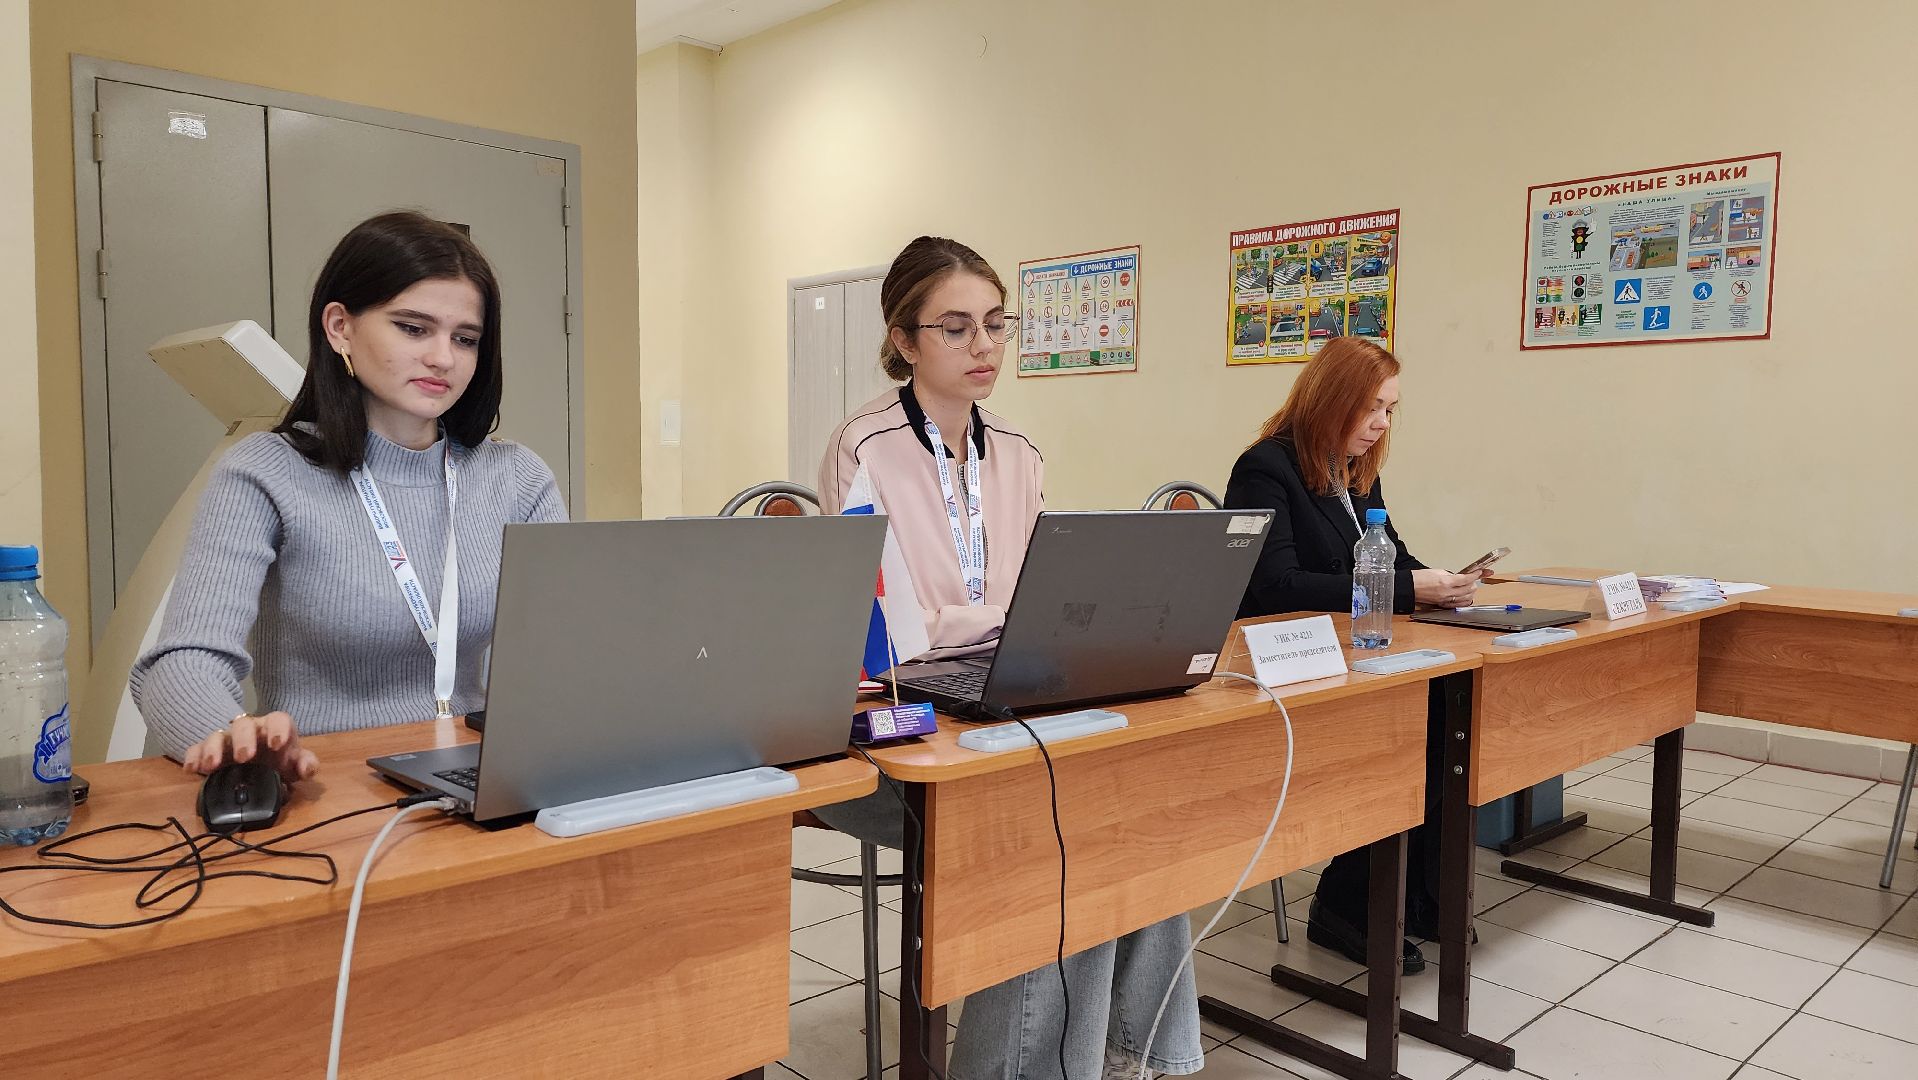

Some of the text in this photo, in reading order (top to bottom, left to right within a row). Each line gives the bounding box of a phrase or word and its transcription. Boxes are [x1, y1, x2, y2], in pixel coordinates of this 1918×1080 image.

[1549, 166, 1748, 205] ДОРОЖНЫЕ ЗНАКИ
[1232, 213, 1397, 247] ПРАВИЛА ДОРОЖНОГО ДВИЖЕНИЯ
[1080, 258, 1133, 274] ДОРОЖНЫЕ ЗНАКИ
[1227, 538, 1254, 548] acer
[1257, 645, 1337, 664] Заместитель председателя
